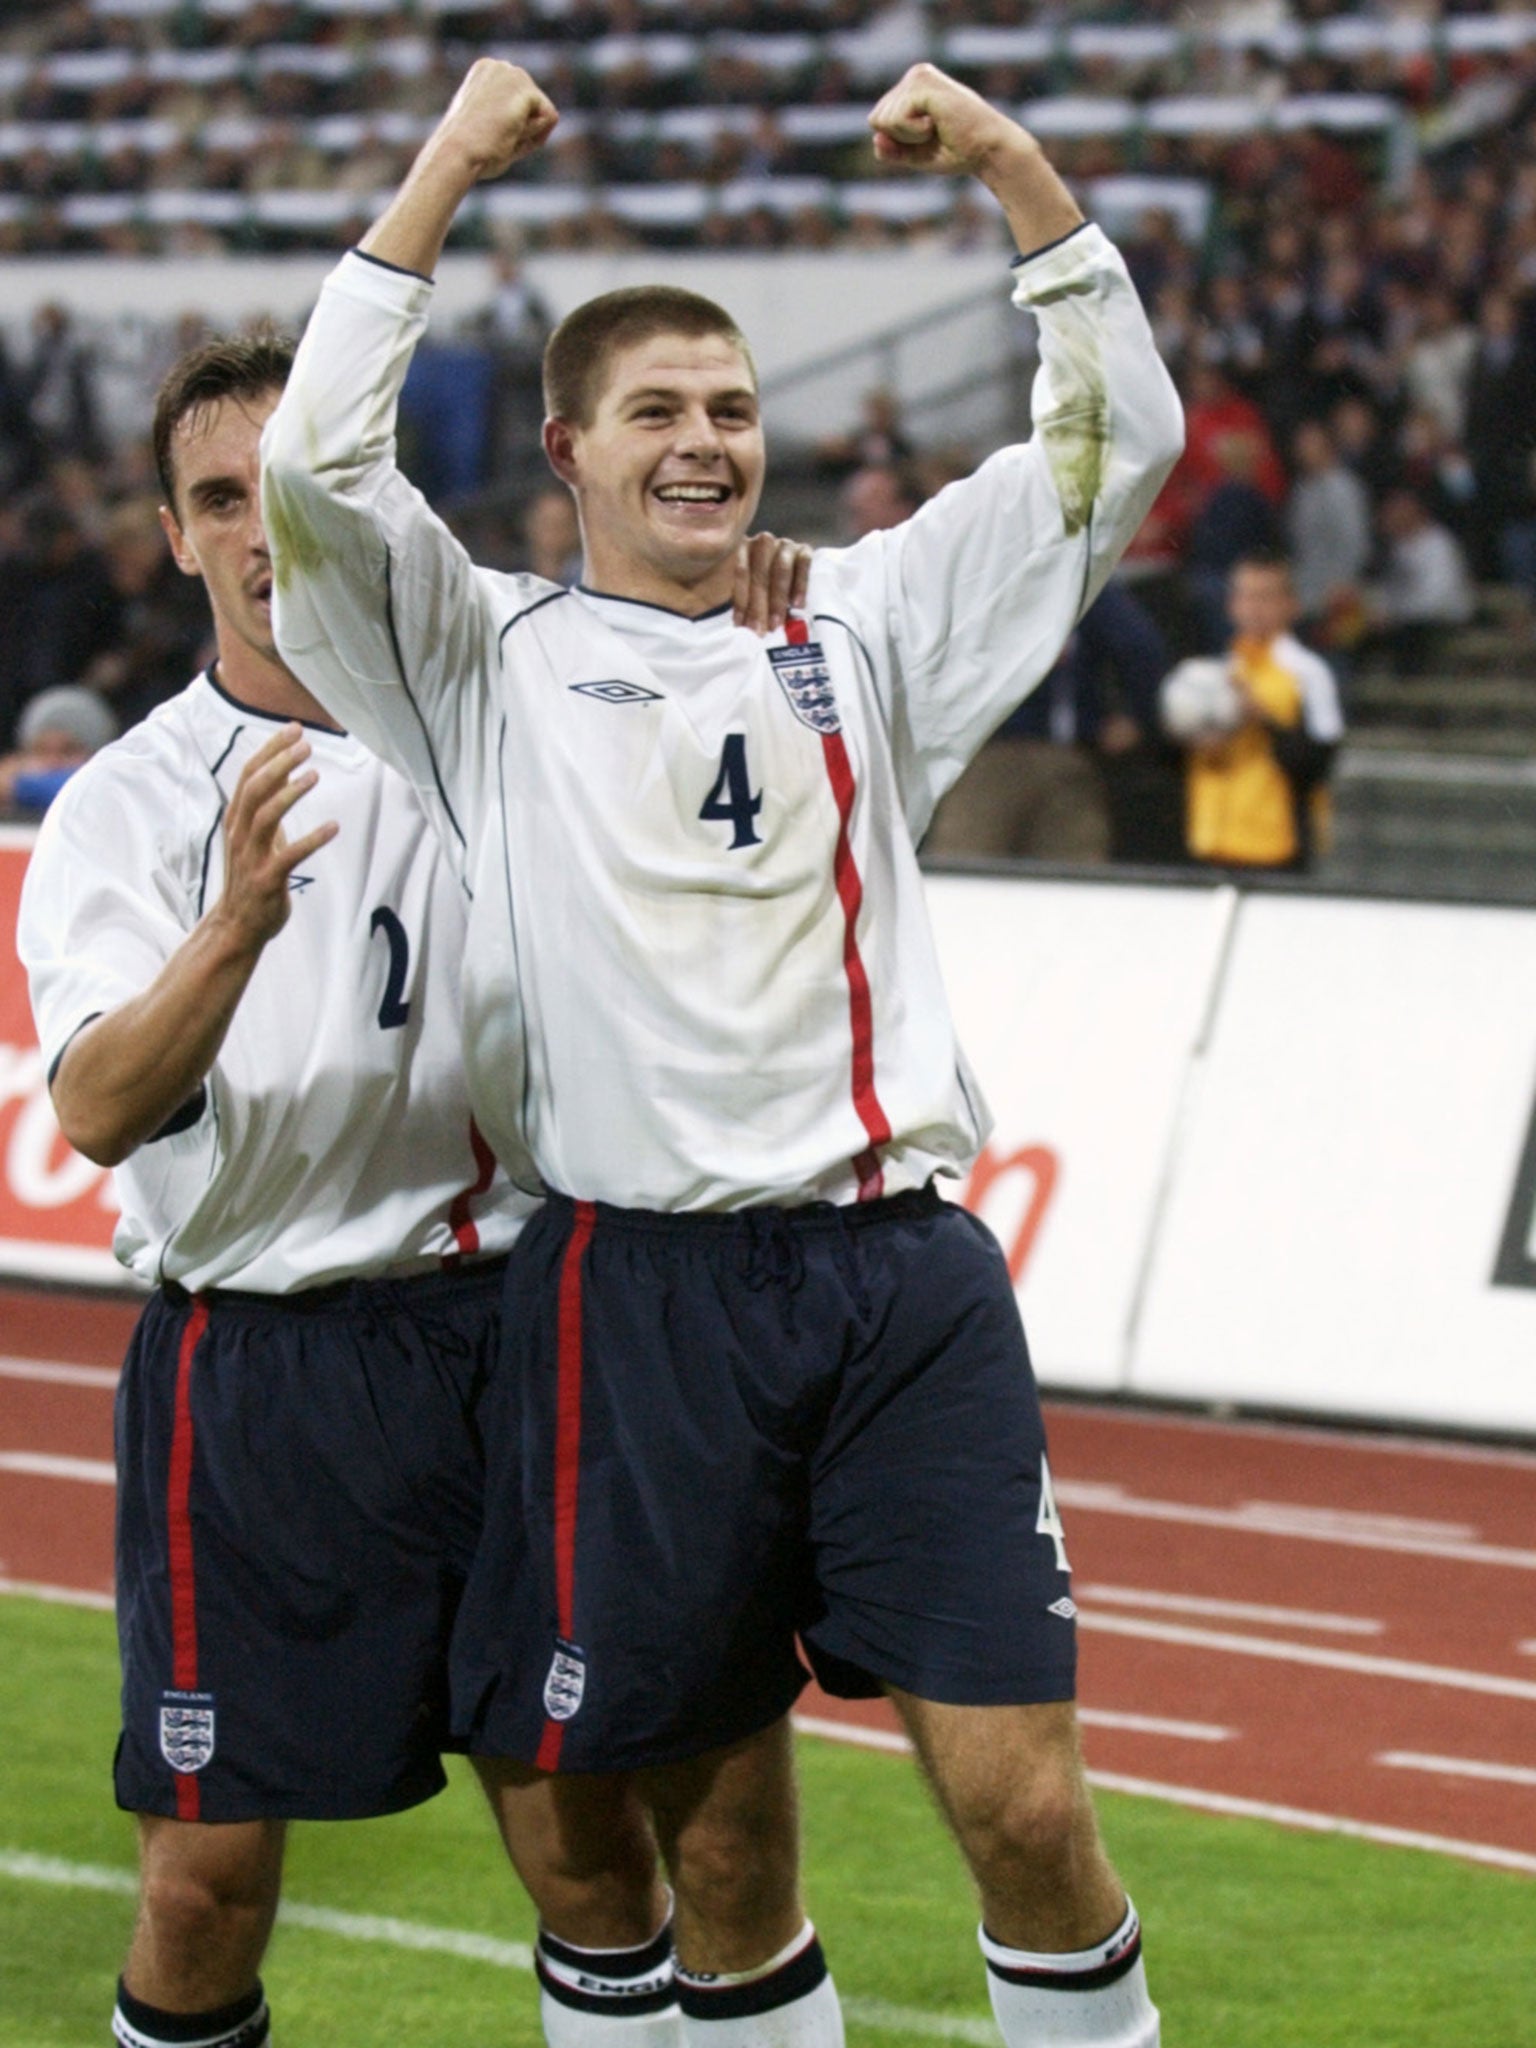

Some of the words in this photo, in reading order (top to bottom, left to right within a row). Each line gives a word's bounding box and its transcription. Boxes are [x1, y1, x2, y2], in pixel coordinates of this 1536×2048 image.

[698, 733, 764, 850] 4
[370, 905, 410, 1030] 2
[1035, 1450, 1072, 1573] 4
